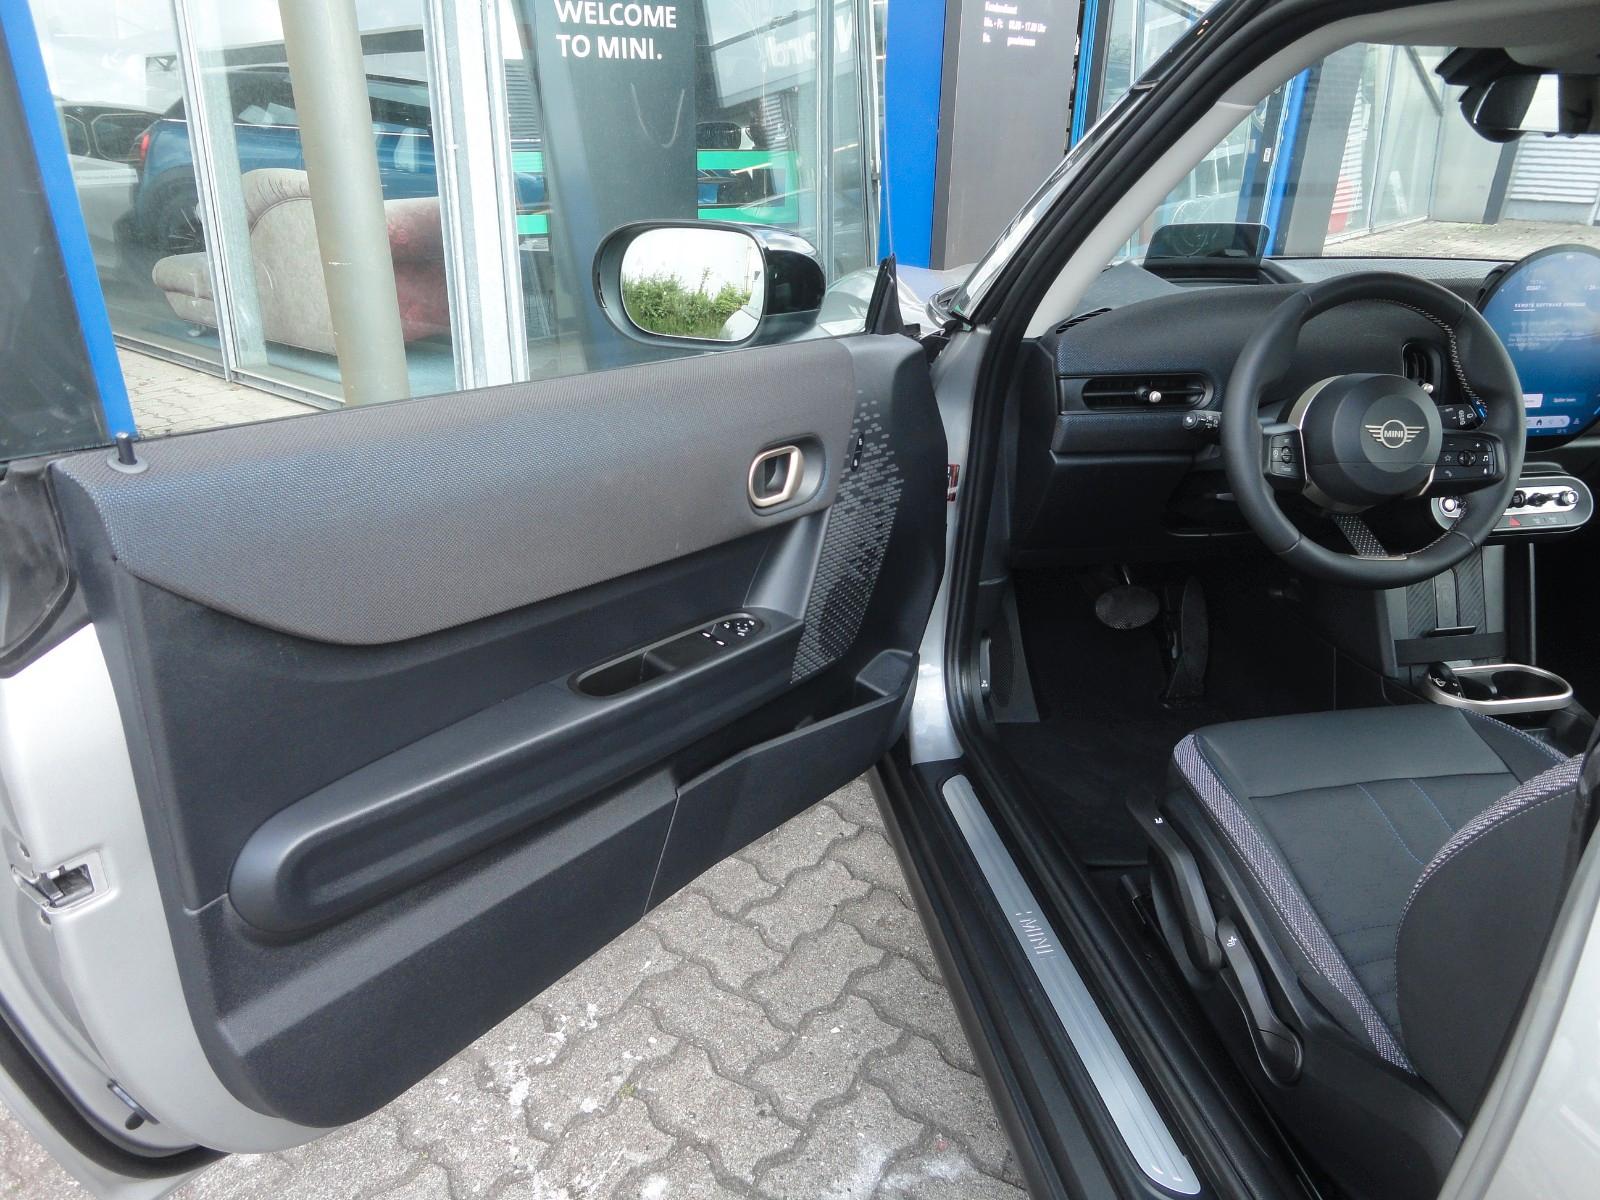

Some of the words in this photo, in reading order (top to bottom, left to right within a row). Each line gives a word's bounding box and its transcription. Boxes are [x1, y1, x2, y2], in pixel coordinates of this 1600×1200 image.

[553, 0, 677, 28] WELCOME
[555, 34, 591, 58] TO
[597, 36, 662, 60] MINI.
[1383, 430, 1404, 439] MINI
